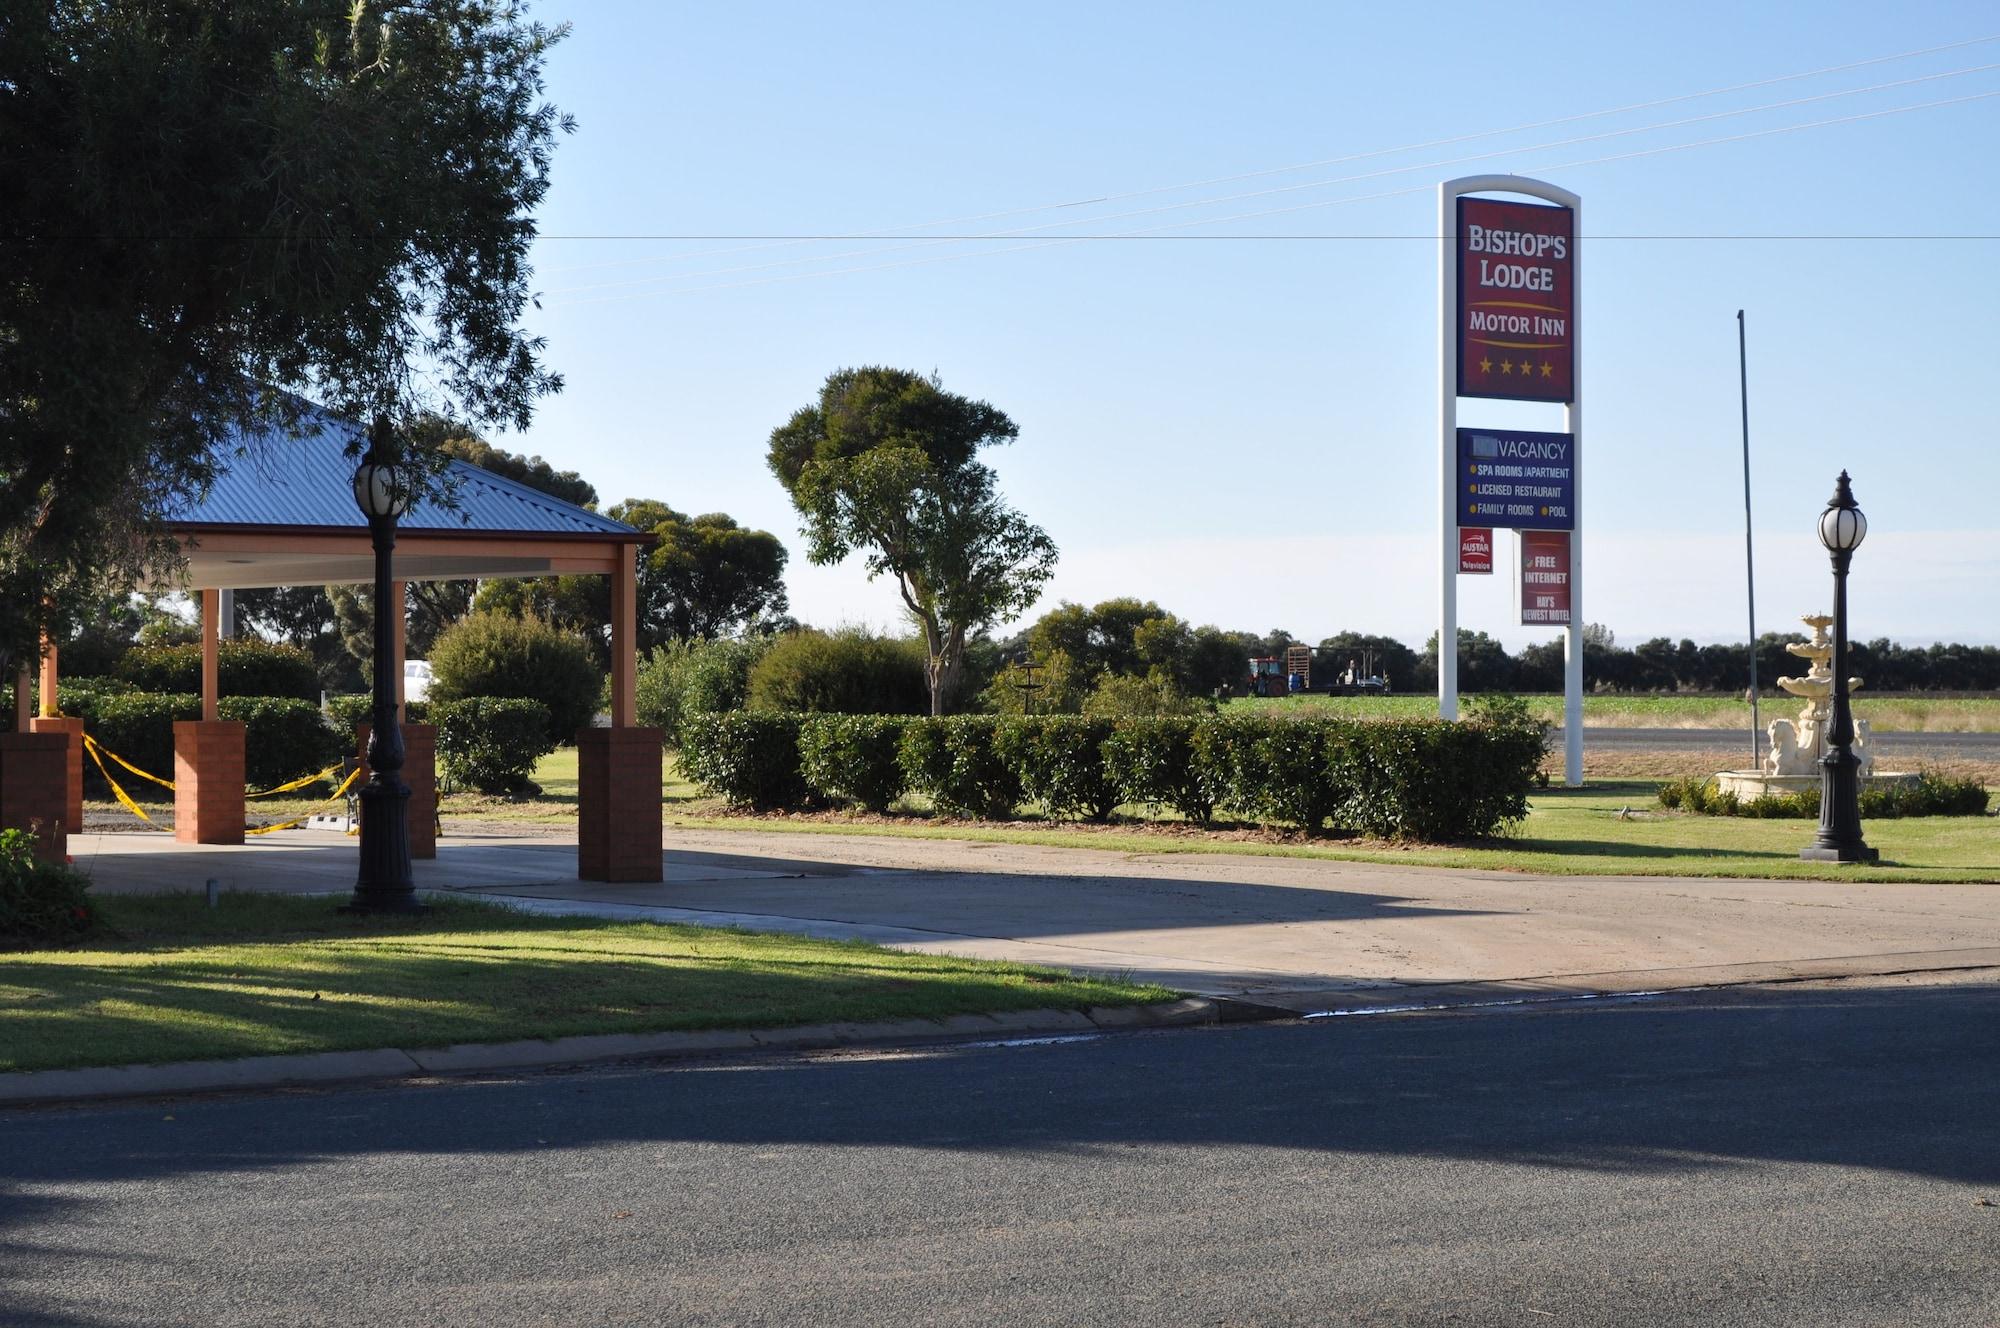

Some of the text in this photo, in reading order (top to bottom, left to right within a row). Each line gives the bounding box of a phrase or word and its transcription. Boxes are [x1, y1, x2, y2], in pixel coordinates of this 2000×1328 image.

[1469, 225, 1566, 259] BISHOP'S
[1481, 260, 1553, 291] LODGE
[1470, 312, 1565, 336] MOTOR INN
[1499, 440, 1566, 460] VACANCY
[1478, 465, 1493, 476] SPA
[1495, 465, 1522, 477] ROOMS
[1478, 484, 1561, 498] LICENSED RESTAURANT
[1478, 504, 1567, 517] FAMILY ROOMS POOL
[1462, 543, 1489, 552] AUSTAR
[1535, 556, 1556, 568] FREE
[1525, 572, 1567, 584] INTERNET
[1537, 596, 1555, 608] HAY'S
[1523, 609, 1570, 621] NEWEST MOTEL
